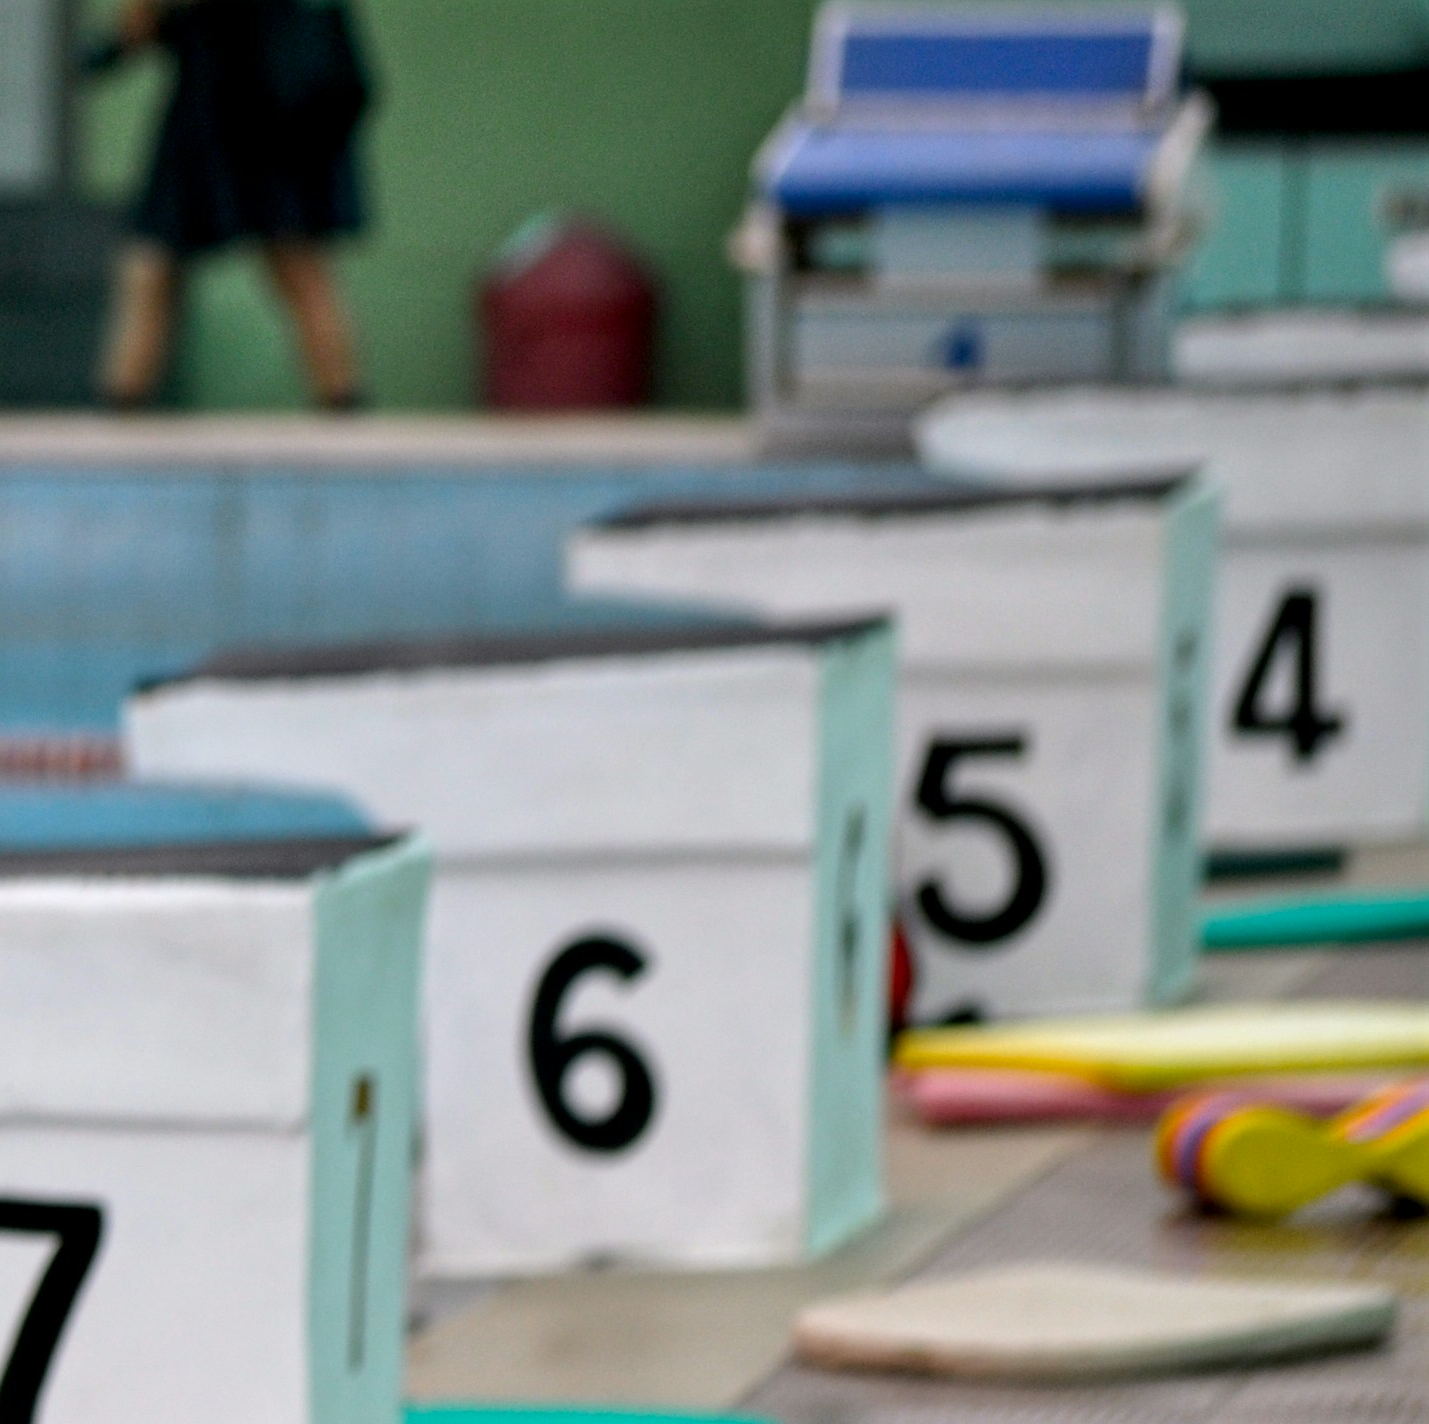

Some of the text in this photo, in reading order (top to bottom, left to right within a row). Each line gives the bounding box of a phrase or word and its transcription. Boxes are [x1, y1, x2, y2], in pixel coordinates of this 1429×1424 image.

[1227, 582, 1347, 768] 4
[913, 730, 1049, 946] 5
[524, 931, 659, 1158] 6
